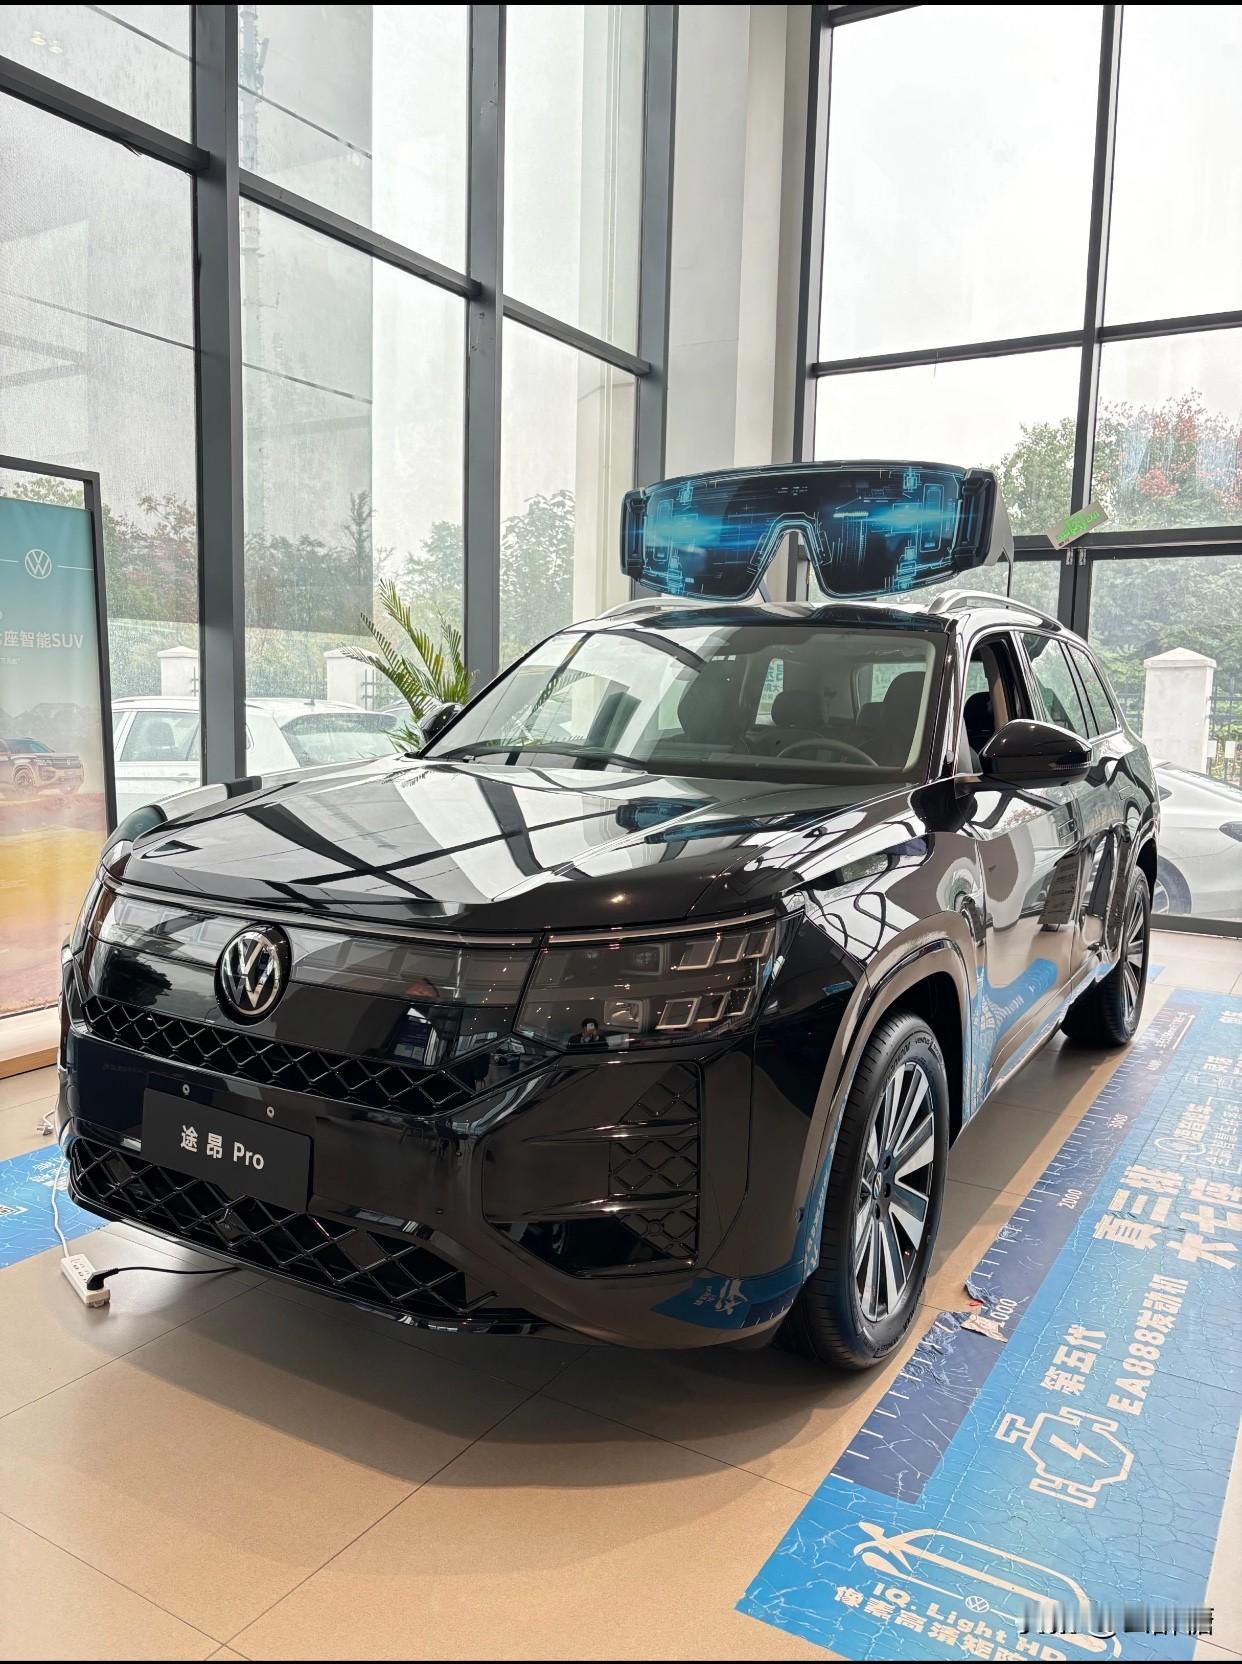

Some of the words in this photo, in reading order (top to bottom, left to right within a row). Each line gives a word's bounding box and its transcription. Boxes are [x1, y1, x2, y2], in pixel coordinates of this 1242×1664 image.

[233, 1141, 266, 1171] Pro
[1058, 1189, 1082, 1210] 2000
[1092, 1164, 1185, 1250] 真三排
[1041, 1324, 1107, 1395] 第五代
[1107, 1274, 1188, 1416] EA888发动机
[926, 1600, 1008, 1645] Light
